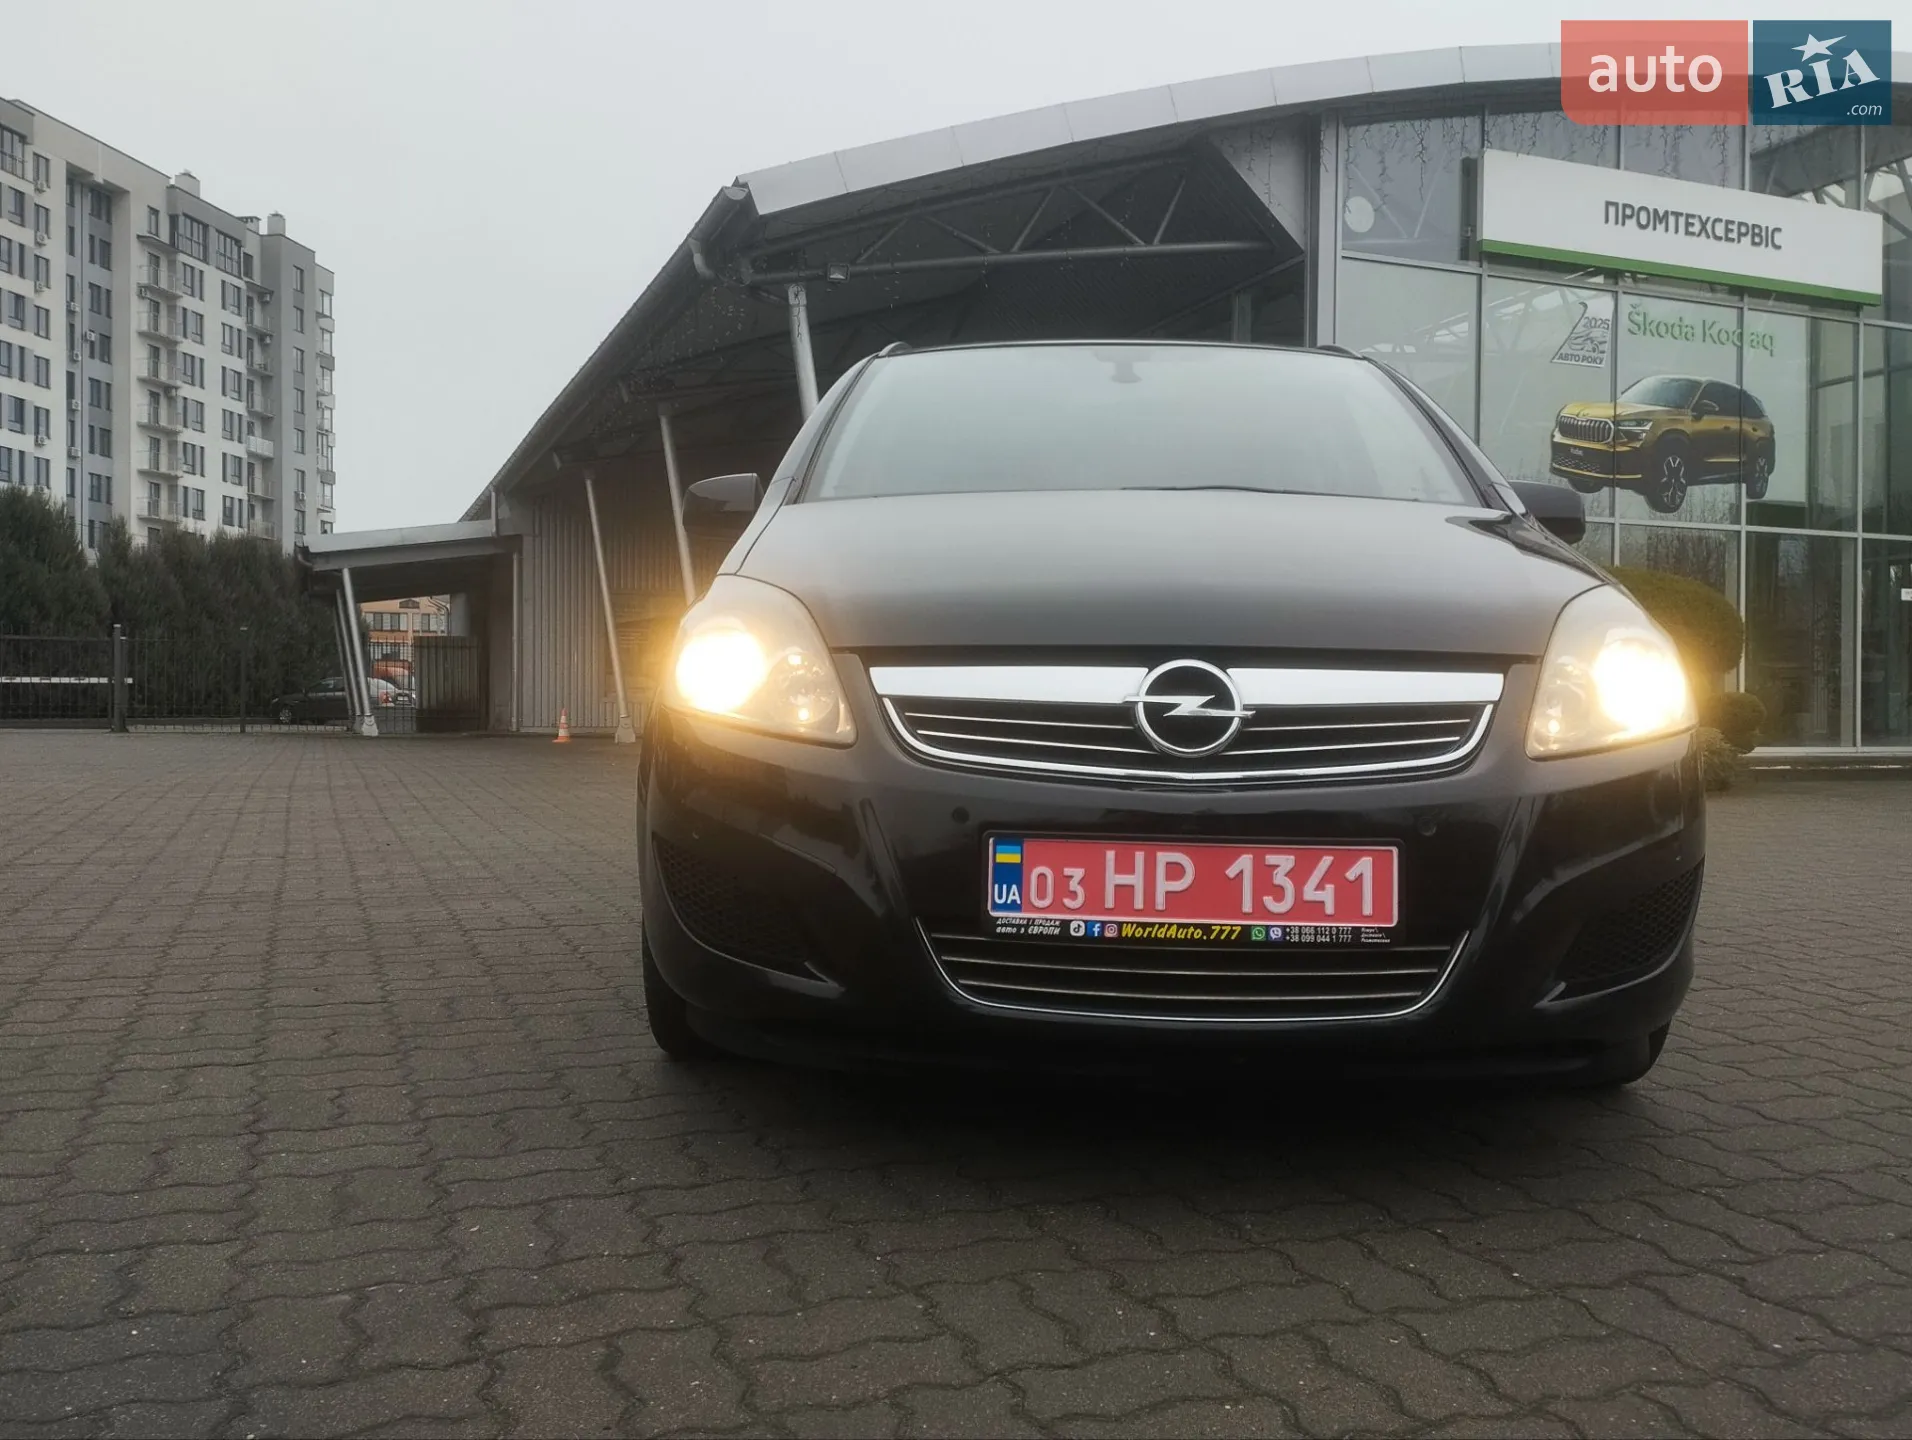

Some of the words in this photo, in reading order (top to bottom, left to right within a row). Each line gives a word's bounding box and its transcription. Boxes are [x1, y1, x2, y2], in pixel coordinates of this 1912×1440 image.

[1604, 200, 1783, 251] ПРОМТЕХСЕРВІС
[1583, 315, 1611, 331] 2025
[1627, 303, 1695, 342] Škoda
[1702, 319, 1775, 358] Kodaq
[1557, 352, 1581, 363] АВТО
[1581, 354, 1605, 365] РОКУ
[1028, 865, 1086, 910] 03
[1104, 849, 1196, 911] HP
[1224, 853, 1373, 916] 1341
[994, 883, 1022, 906] UA
[1121, 923, 1242, 941] WorldAuto.777
